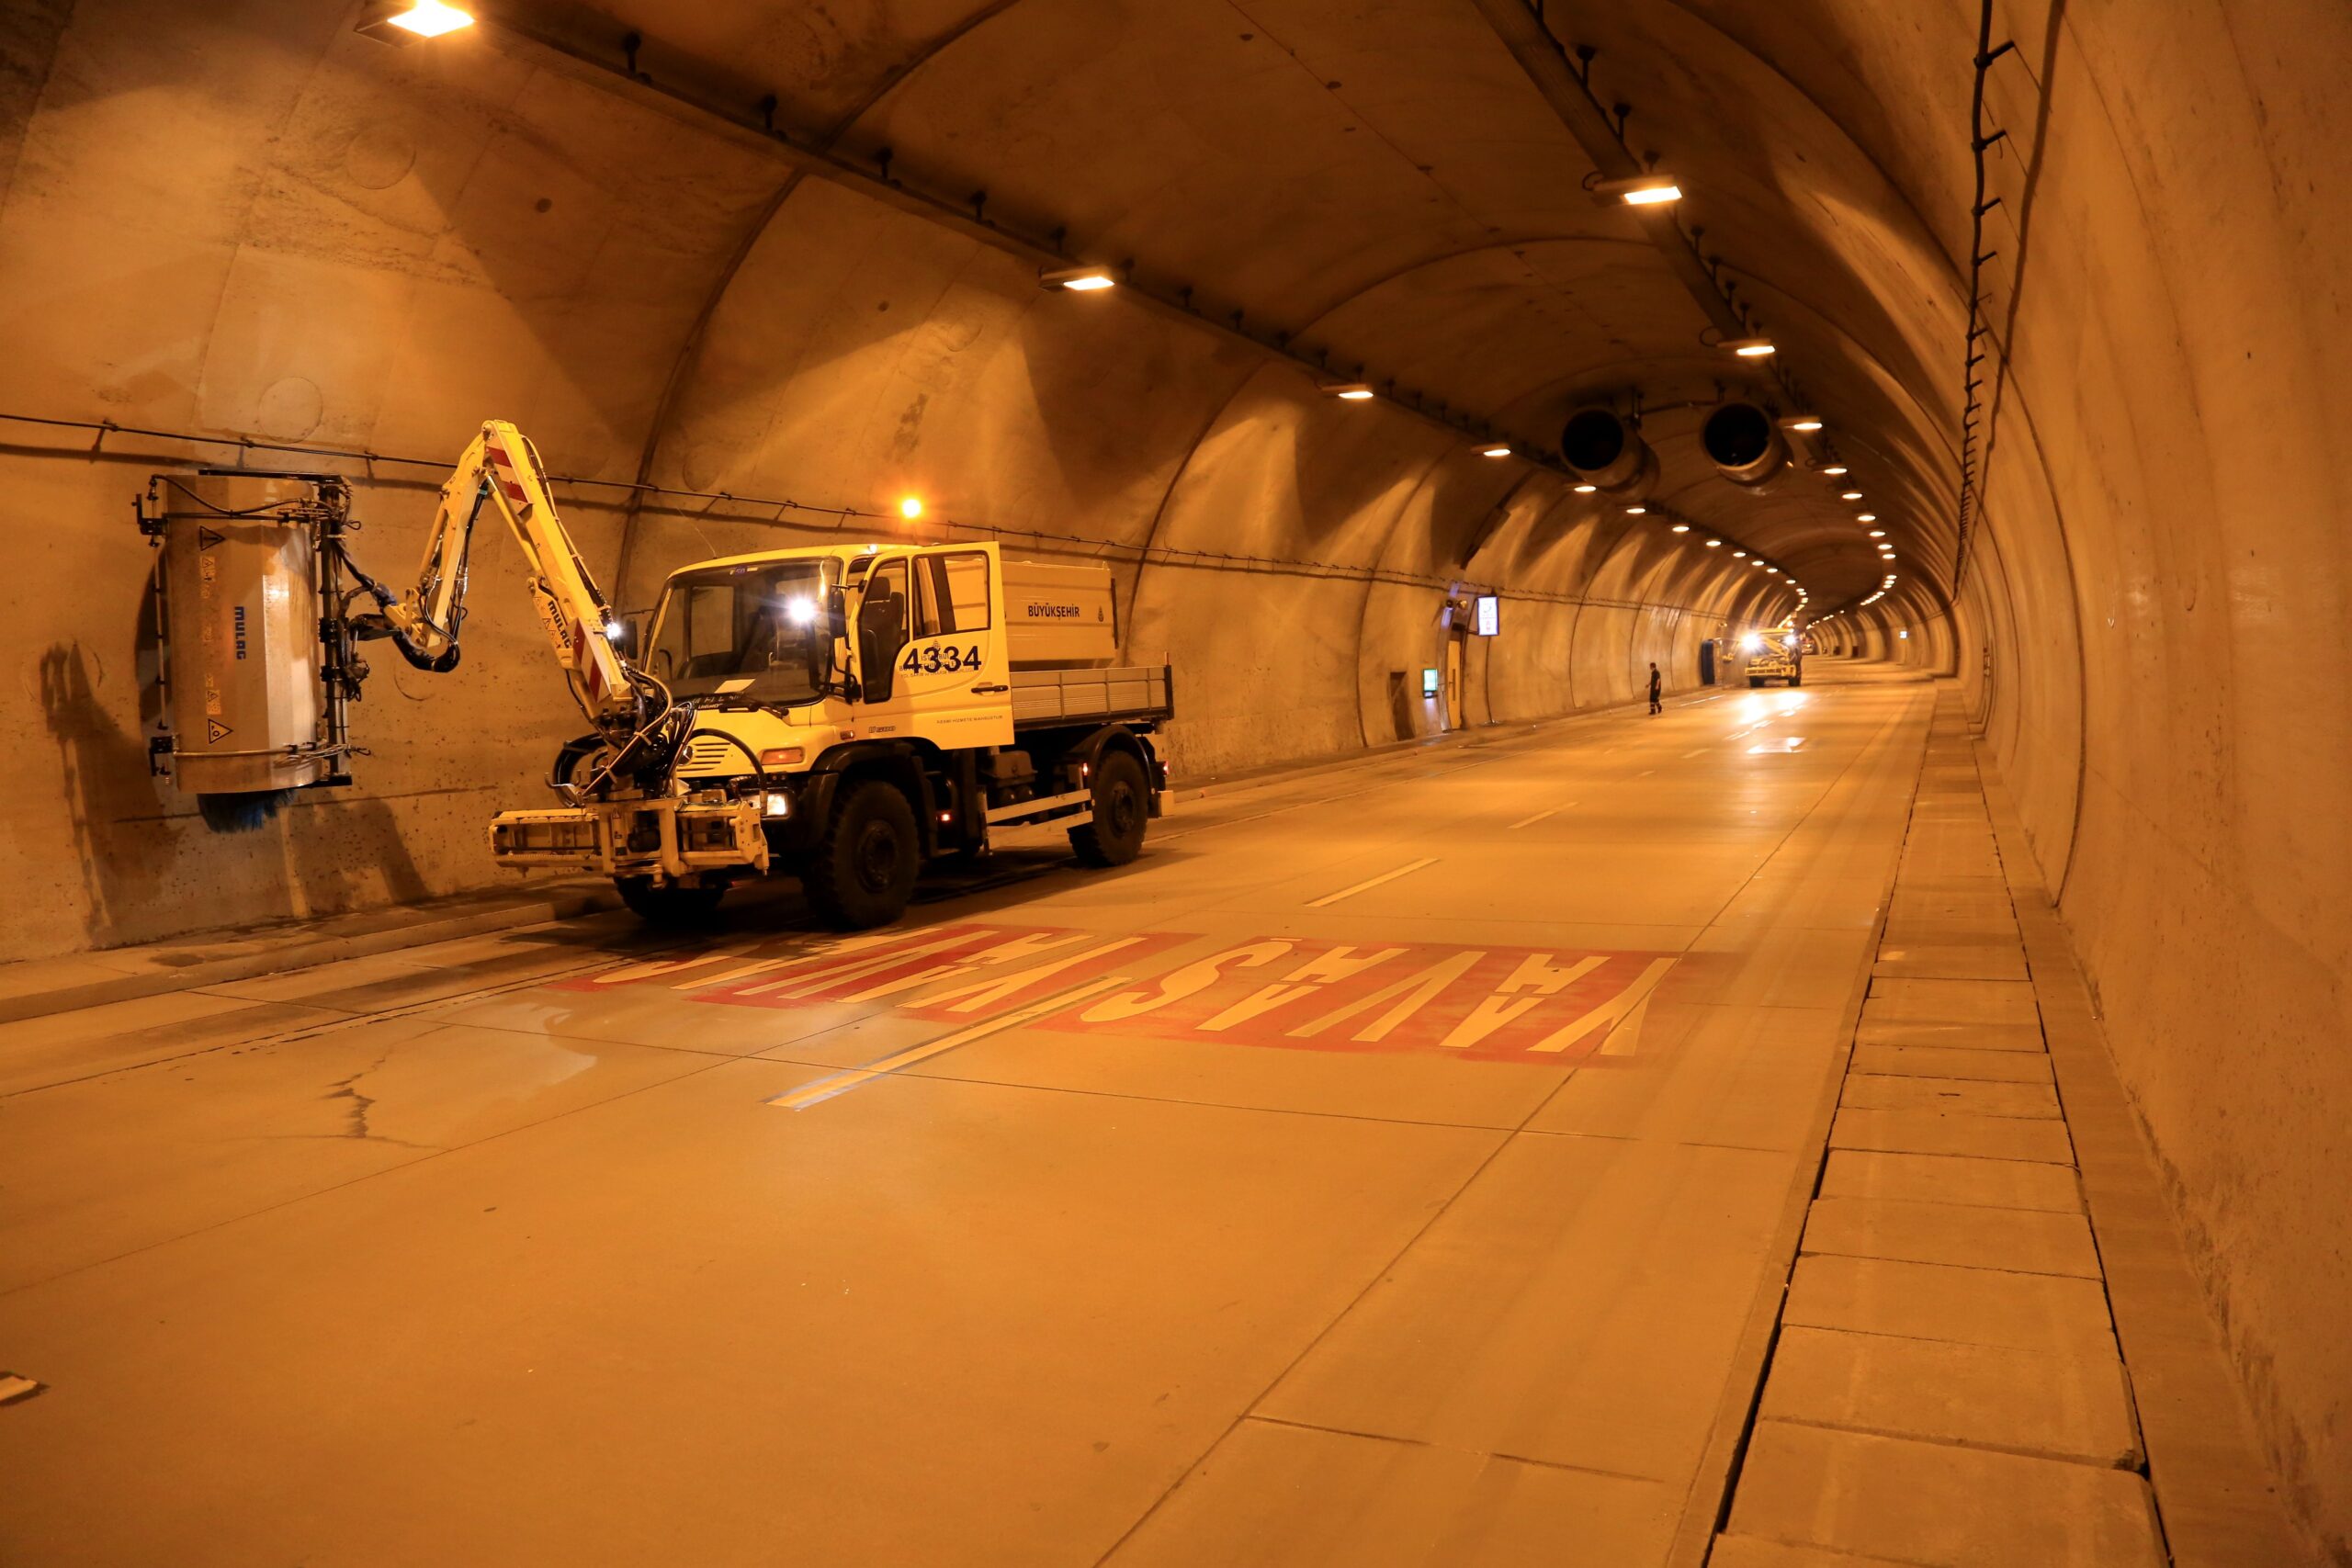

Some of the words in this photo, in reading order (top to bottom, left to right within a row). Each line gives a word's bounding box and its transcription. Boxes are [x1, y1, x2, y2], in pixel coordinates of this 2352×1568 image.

[548, 600, 572, 649] MULAG
[1028, 603, 1080, 620] BÜYÜKŞEHİR
[234, 606, 246, 660] MULAG
[903, 646, 981, 673] 4334
